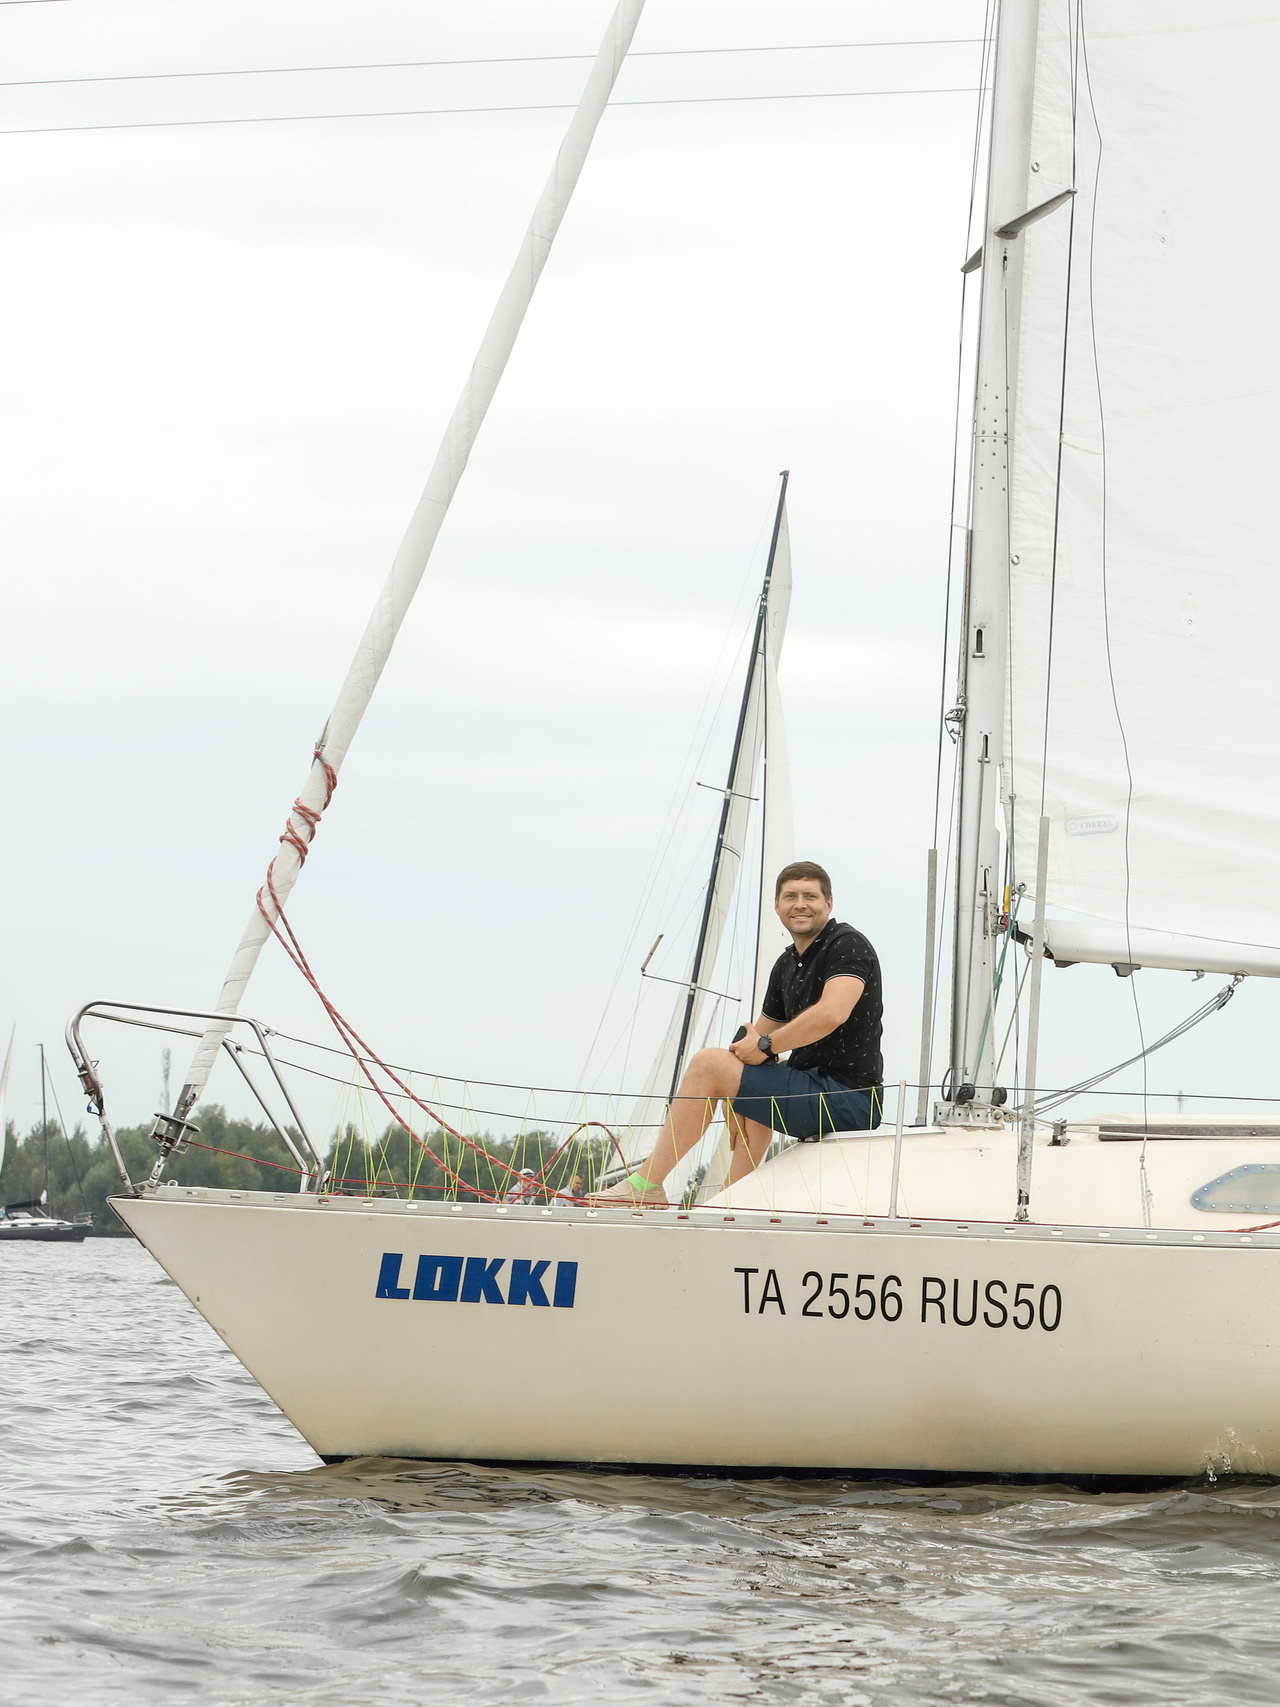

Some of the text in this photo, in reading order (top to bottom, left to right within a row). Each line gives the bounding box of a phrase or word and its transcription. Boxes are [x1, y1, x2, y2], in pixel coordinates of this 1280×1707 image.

[376, 1253, 577, 1307] LOKKI
[735, 1268, 1061, 1331] TA 2556 RUS50
